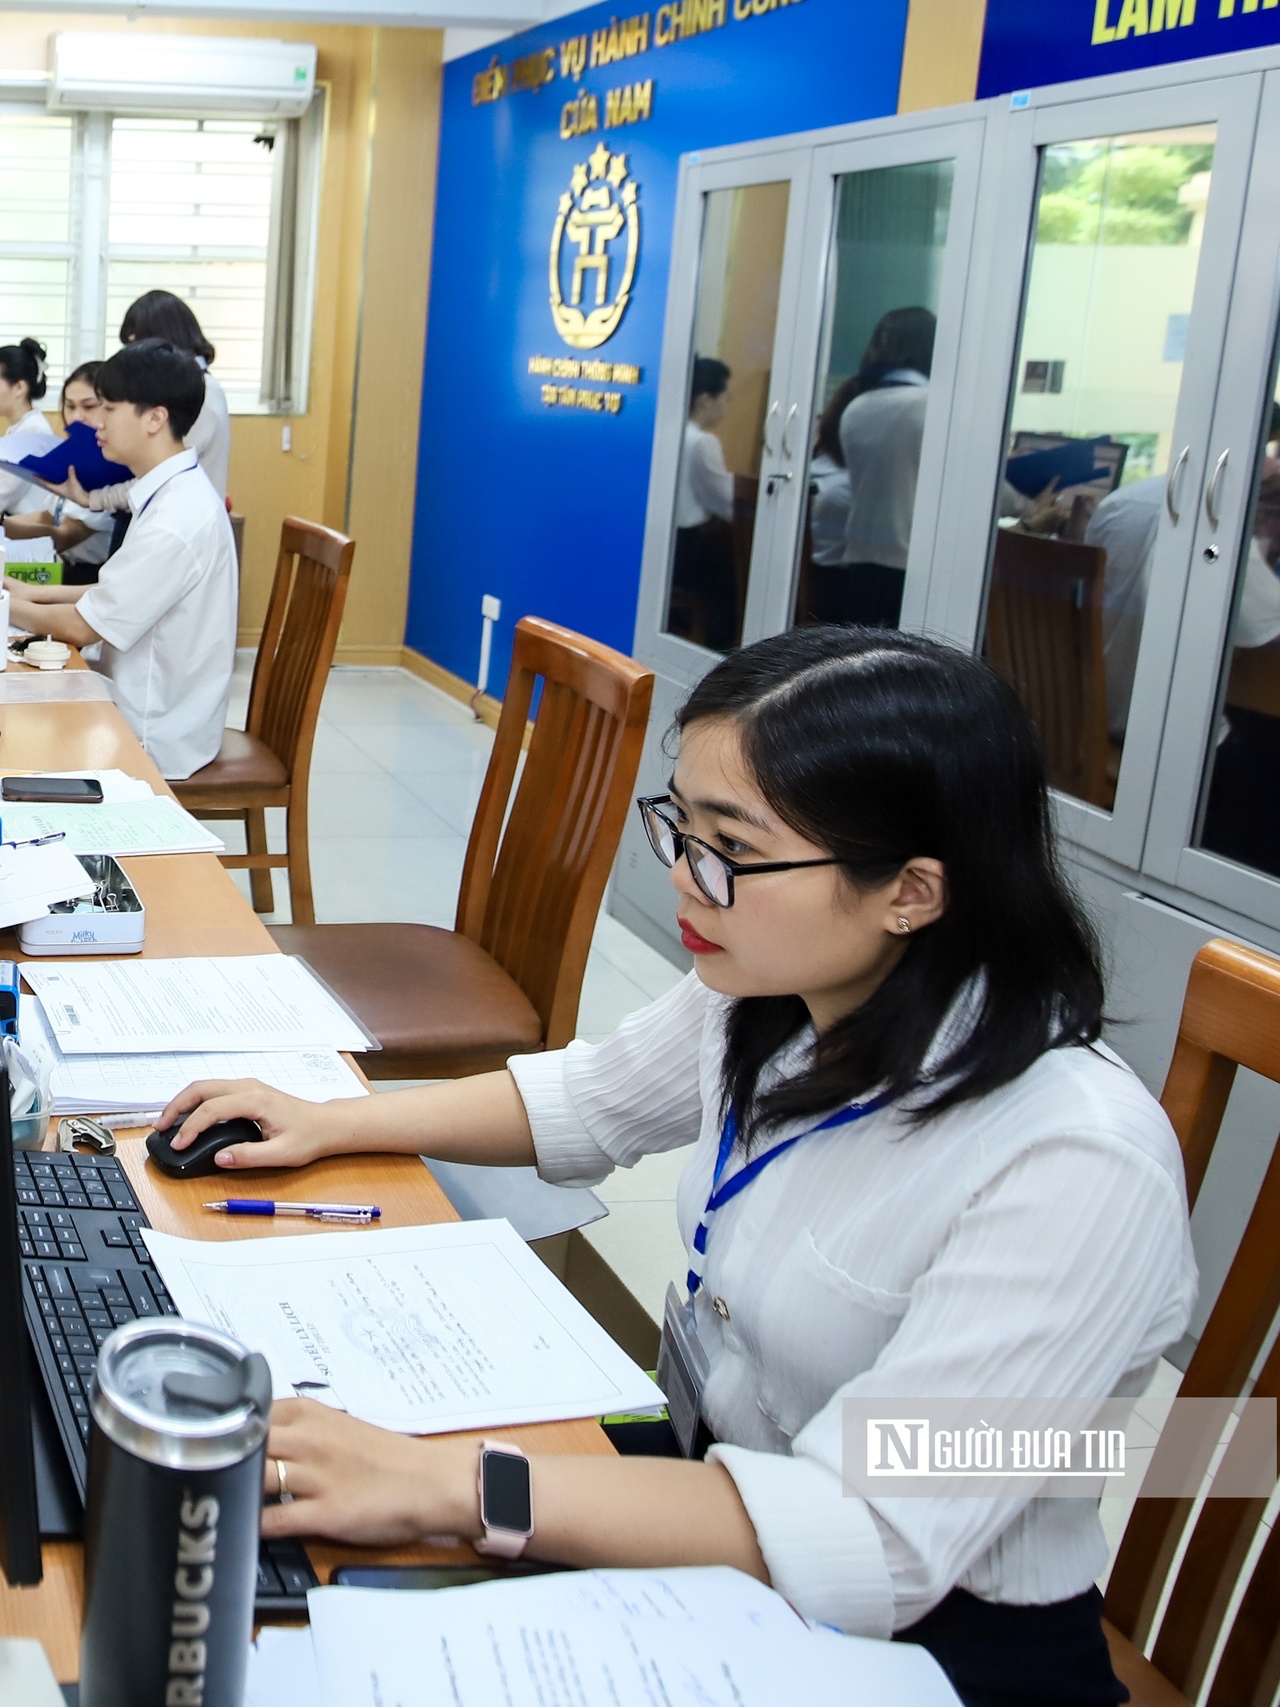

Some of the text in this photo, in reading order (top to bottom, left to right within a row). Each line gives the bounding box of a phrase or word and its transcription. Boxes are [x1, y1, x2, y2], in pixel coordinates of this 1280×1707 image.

[560, 34, 588, 83] VỤ
[590, 13, 650, 69] HÀNH
[605, 78, 653, 129] NAM
